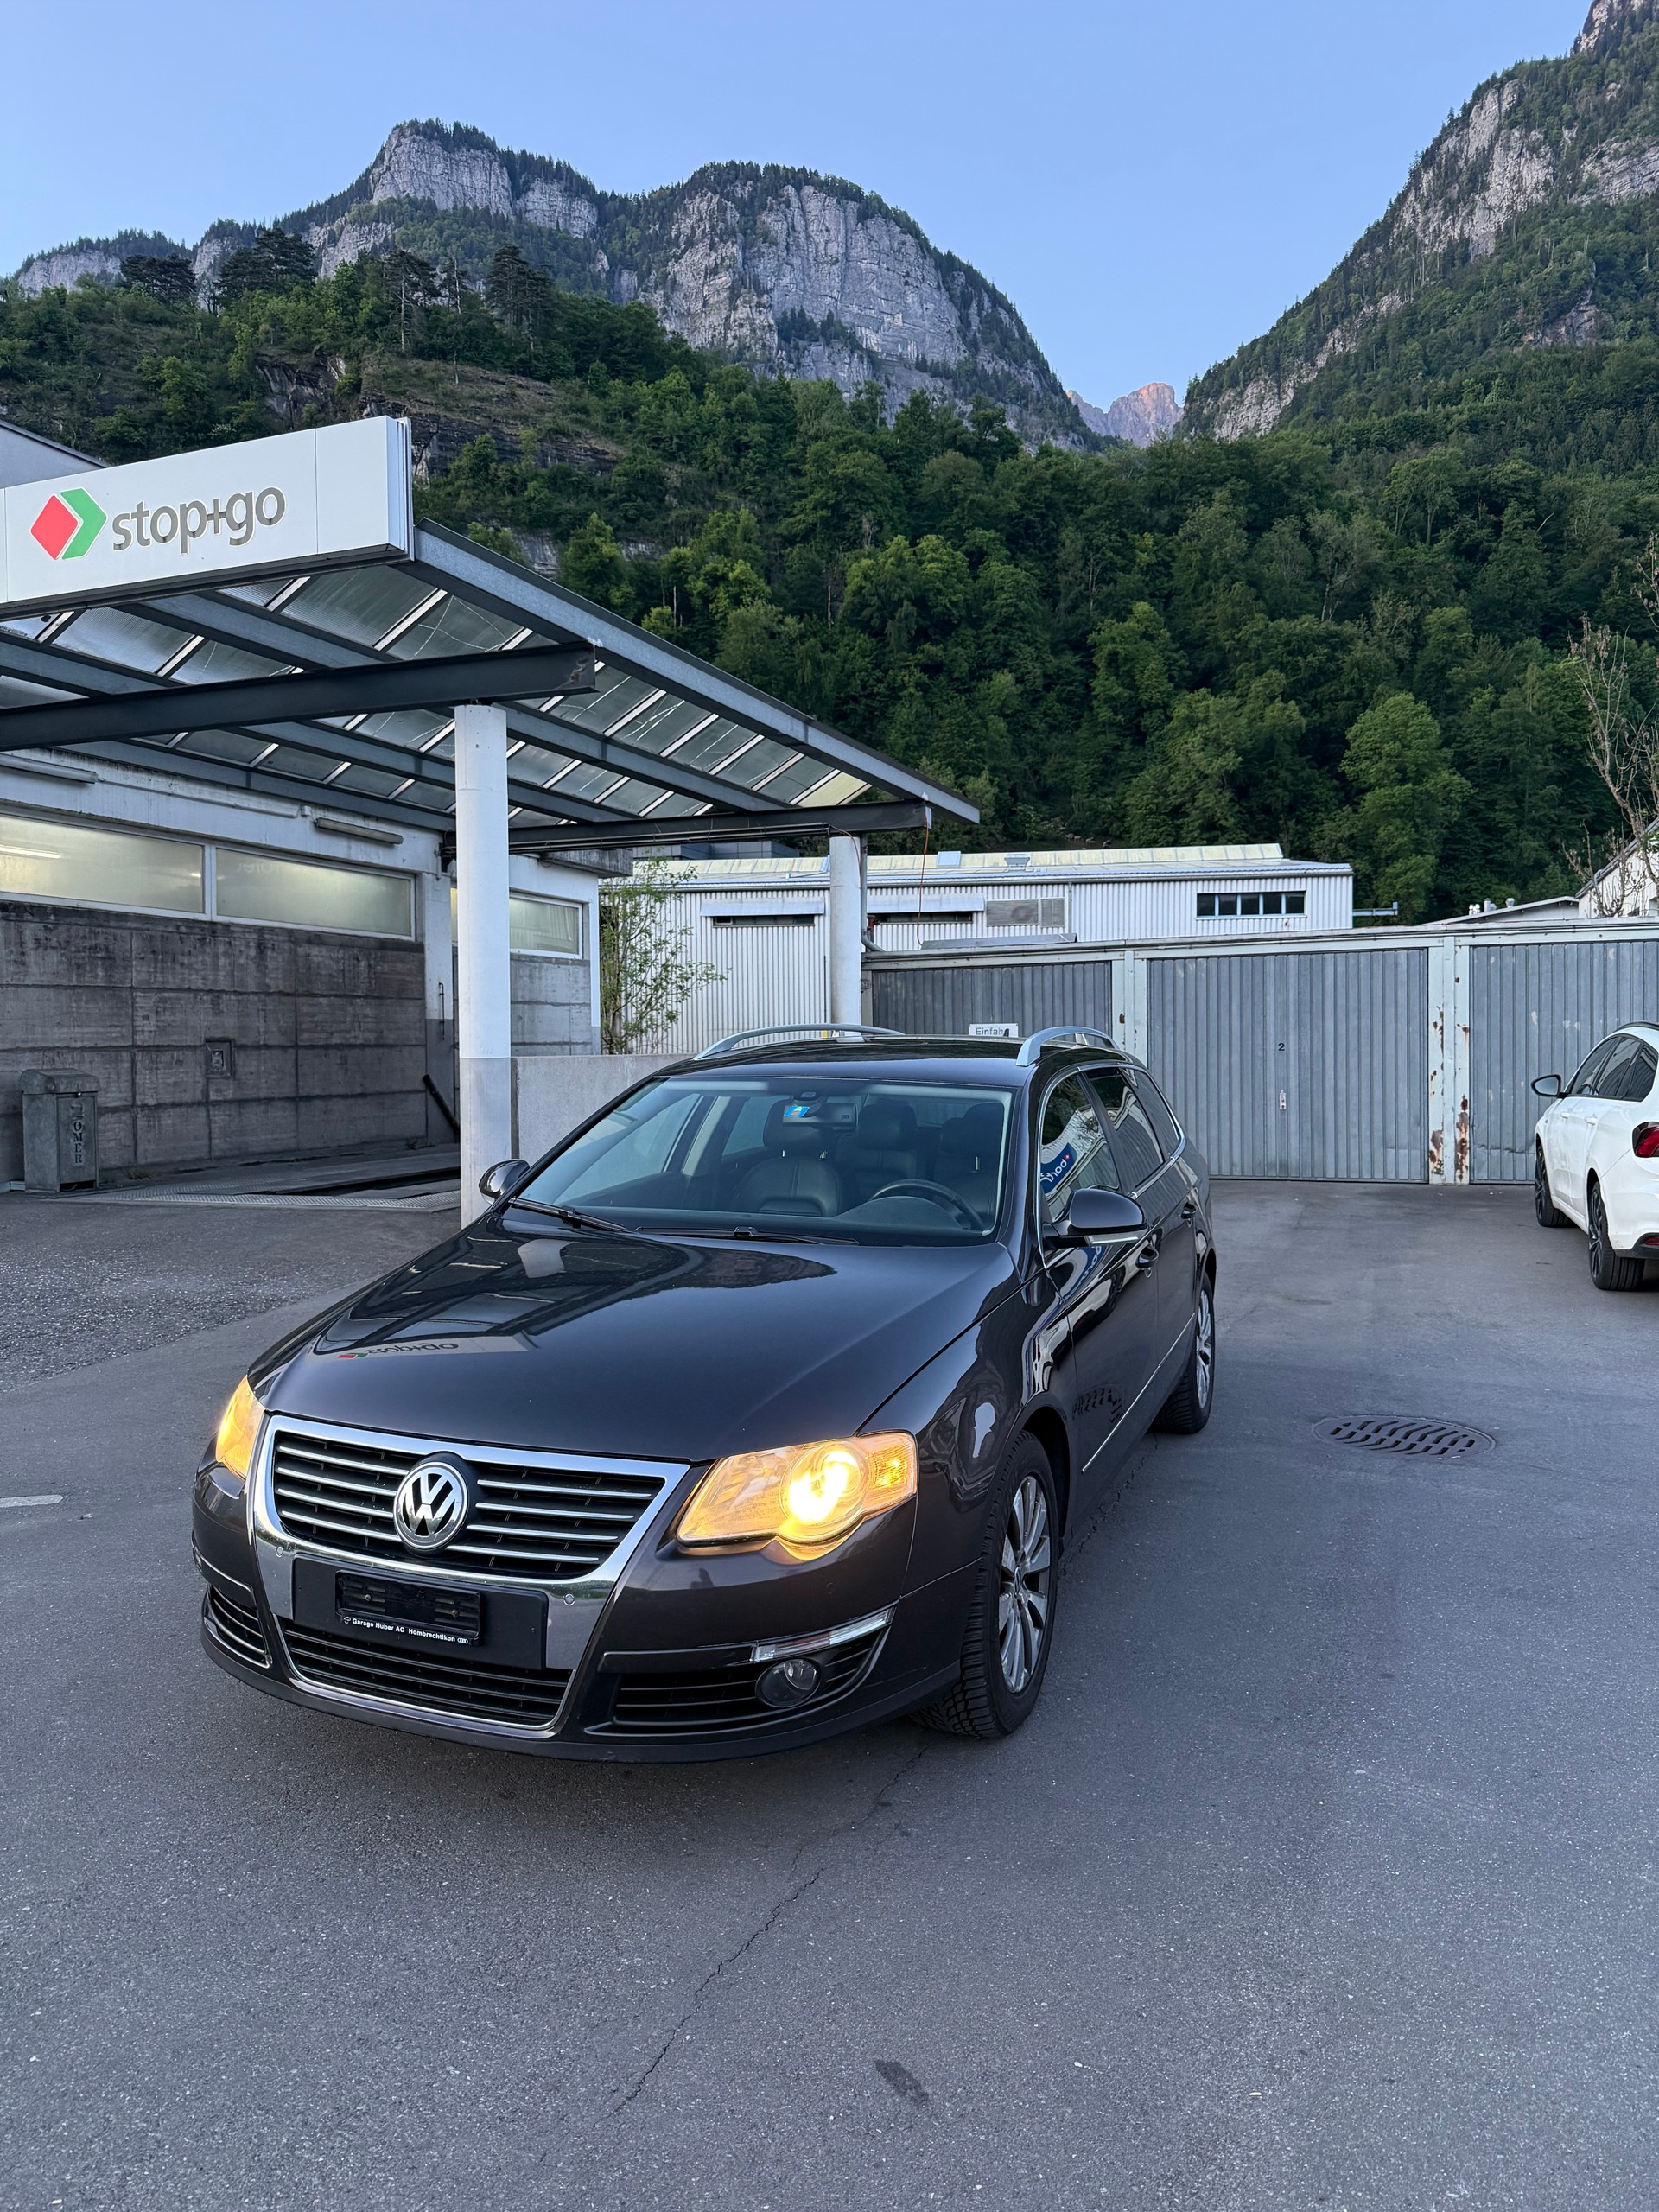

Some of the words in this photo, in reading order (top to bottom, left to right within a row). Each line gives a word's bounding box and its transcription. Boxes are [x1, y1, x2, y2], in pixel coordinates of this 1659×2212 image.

[111, 486, 286, 555] stop+go
[975, 1027, 1005, 1036] Einfah
[1278, 1042, 1285, 1052] 2
[397, 1466, 464, 1544] VW
[352, 1618, 374, 1629] Garage
[375, 1622, 394, 1631] Huber
[408, 1628, 456, 1643] Hombrechtikon
